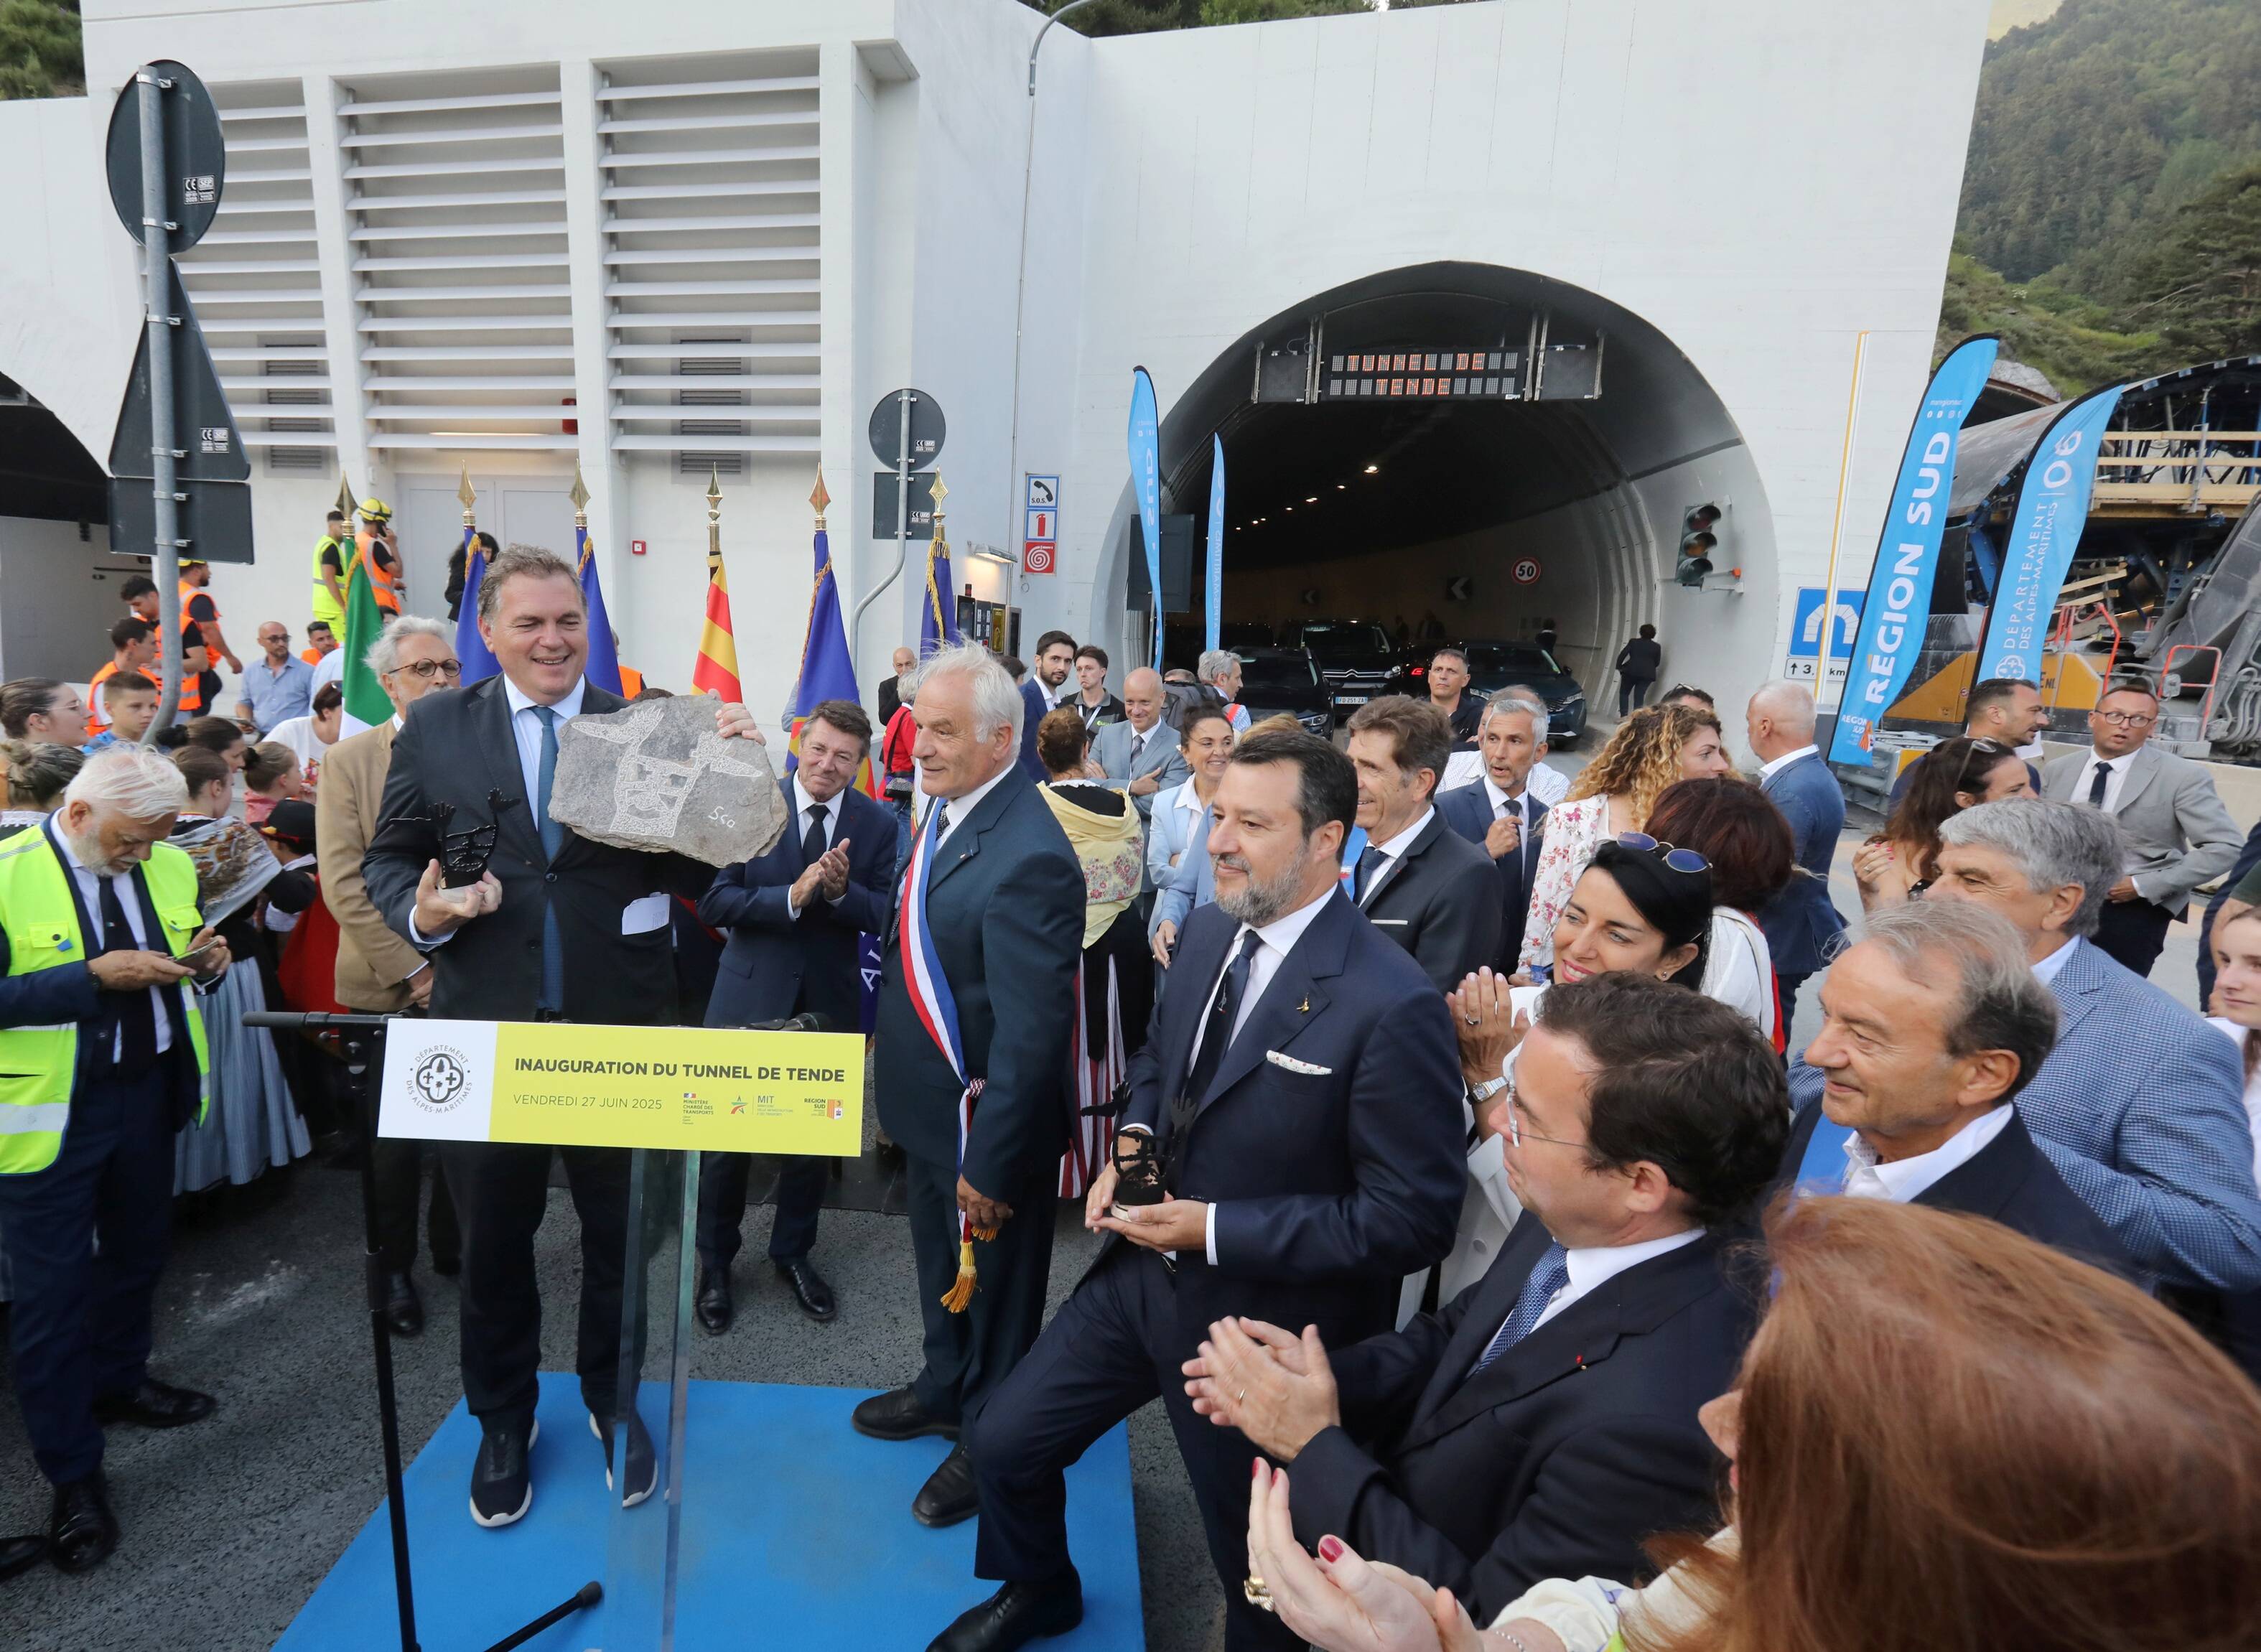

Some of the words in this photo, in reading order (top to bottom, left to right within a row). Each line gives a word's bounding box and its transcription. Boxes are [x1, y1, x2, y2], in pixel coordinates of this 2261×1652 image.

[1347, 353, 1437, 372] TUNNEL
[1456, 350, 1486, 371] DE
[1376, 378, 1451, 396] TENDE
[2043, 431, 2082, 488] 06
[1906, 431, 1951, 526] SUD
[1518, 565, 1535, 577] 50
[2003, 503, 2048, 649] DÉPARTEMENT
[2018, 626, 2032, 649] DES
[2025, 503, 2059, 622] ALPES-MARITIMES
[1829, 668, 1845, 676] km
[414, 1045, 469, 1064] DÉPARTEMENT
[515, 1058, 647, 1075] INAUGURATION
[653, 1063, 678, 1076] DU
[683, 1064, 752, 1079] TUNNEL
[757, 1067, 781, 1080] DE
[786, 1068, 845, 1082] TENDE
[406, 1080, 415, 1096] DES
[411, 1081, 472, 1114] ALPES-MARITIMES
[513, 1094, 577, 1106] VENDREDI
[582, 1096, 596, 1107] 27
[600, 1098, 628, 1108] JUIN
[632, 1099, 662, 1109] 2025
[757, 1095, 775, 1103] MIT
